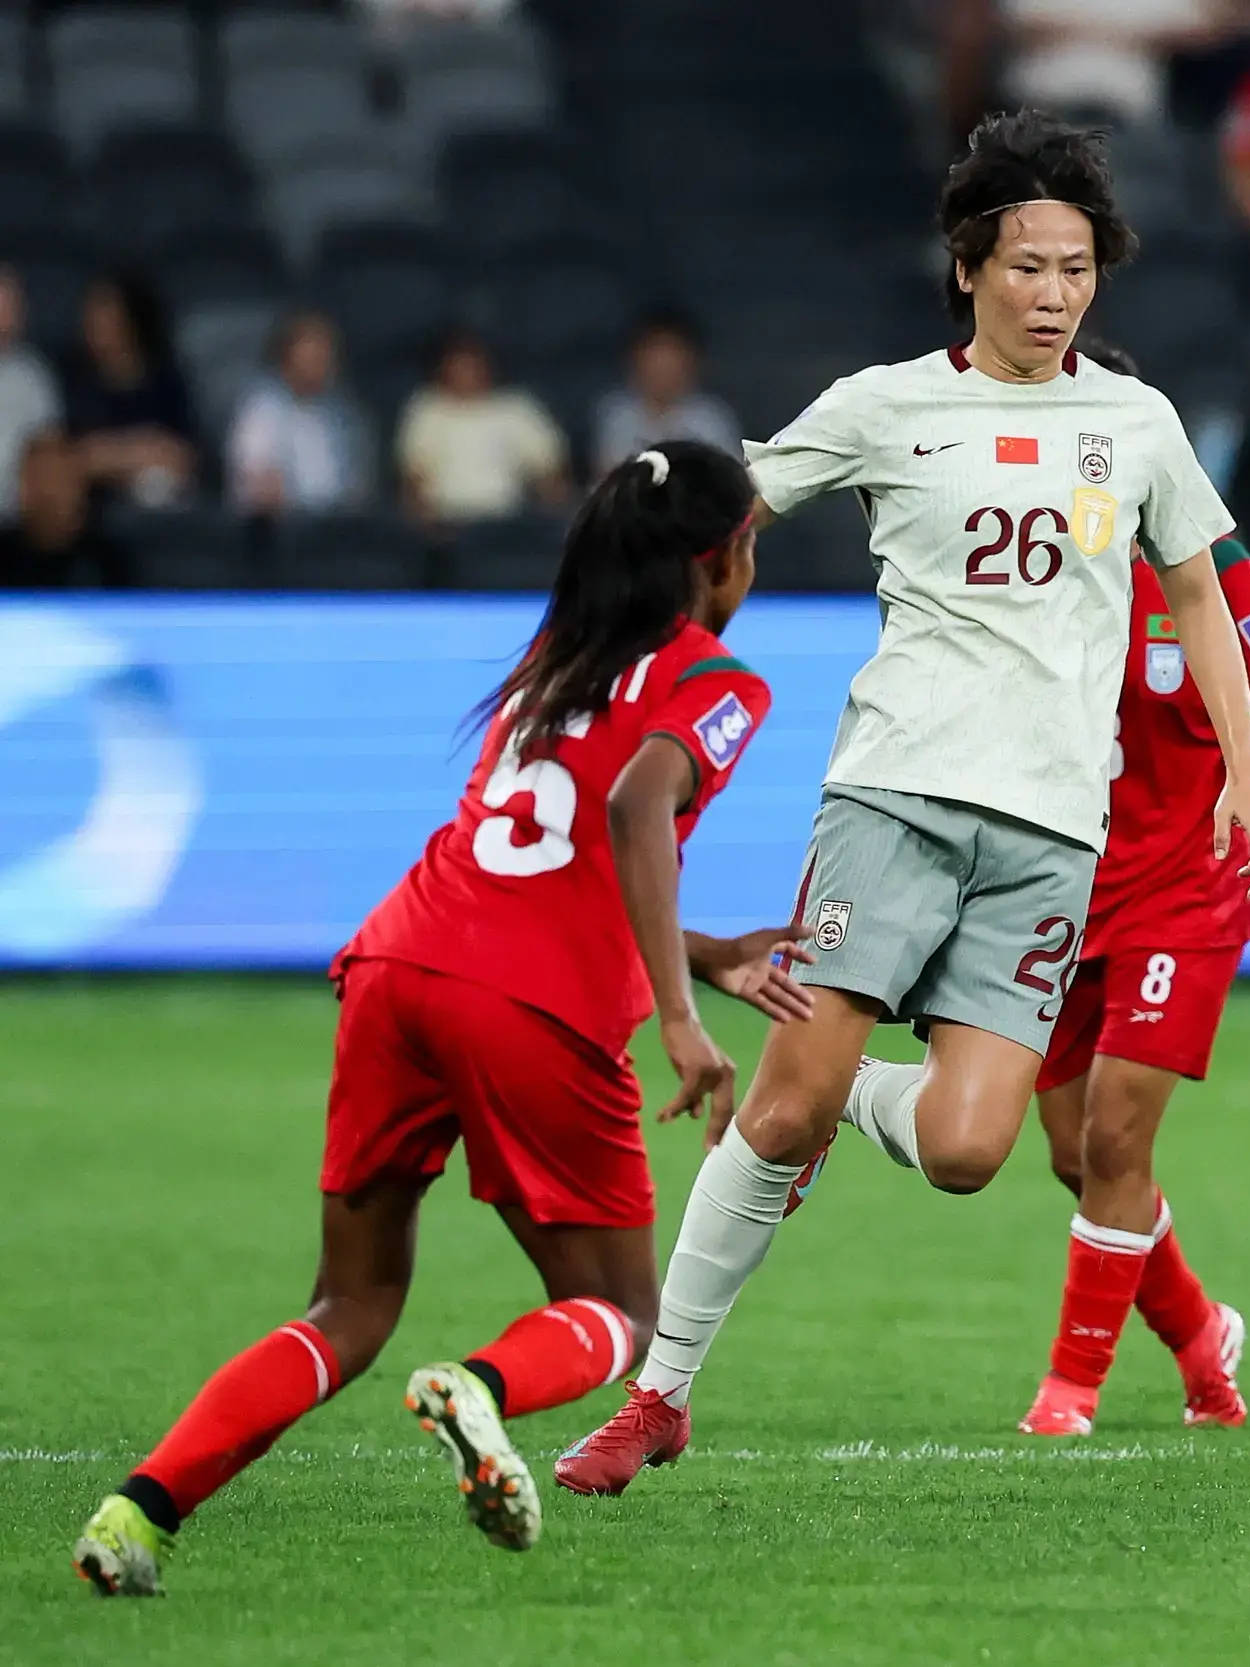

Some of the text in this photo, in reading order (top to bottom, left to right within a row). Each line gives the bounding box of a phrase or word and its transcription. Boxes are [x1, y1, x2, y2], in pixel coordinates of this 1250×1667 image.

[1081, 436, 1109, 448] CFA
[964, 506, 1069, 586] 26
[472, 709, 594, 877] 5
[823, 903, 849, 914] CFA
[1140, 953, 1176, 1004] 8
